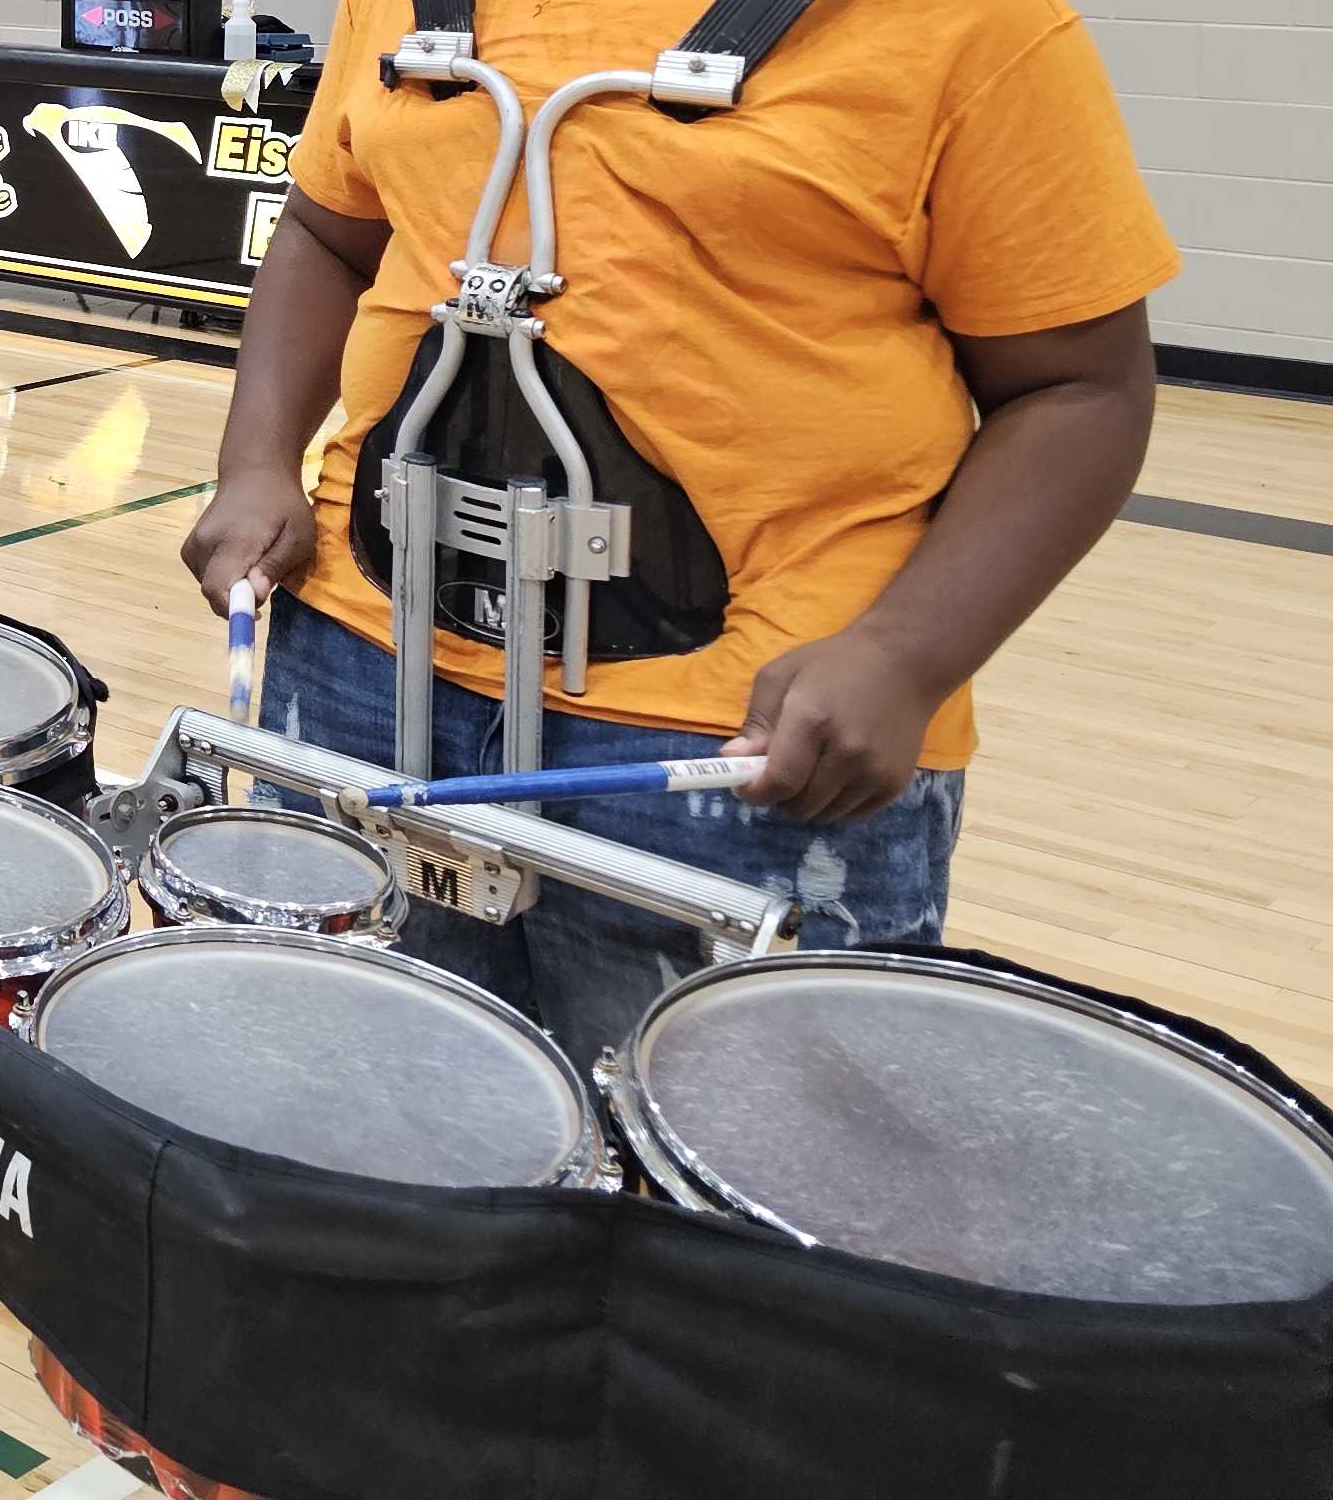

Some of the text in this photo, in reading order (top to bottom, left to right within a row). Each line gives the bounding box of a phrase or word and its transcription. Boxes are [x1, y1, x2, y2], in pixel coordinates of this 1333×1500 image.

[103, 8, 153, 29] POSS
[684, 761, 732, 776] FIRTH
[420, 859, 459, 908] M
